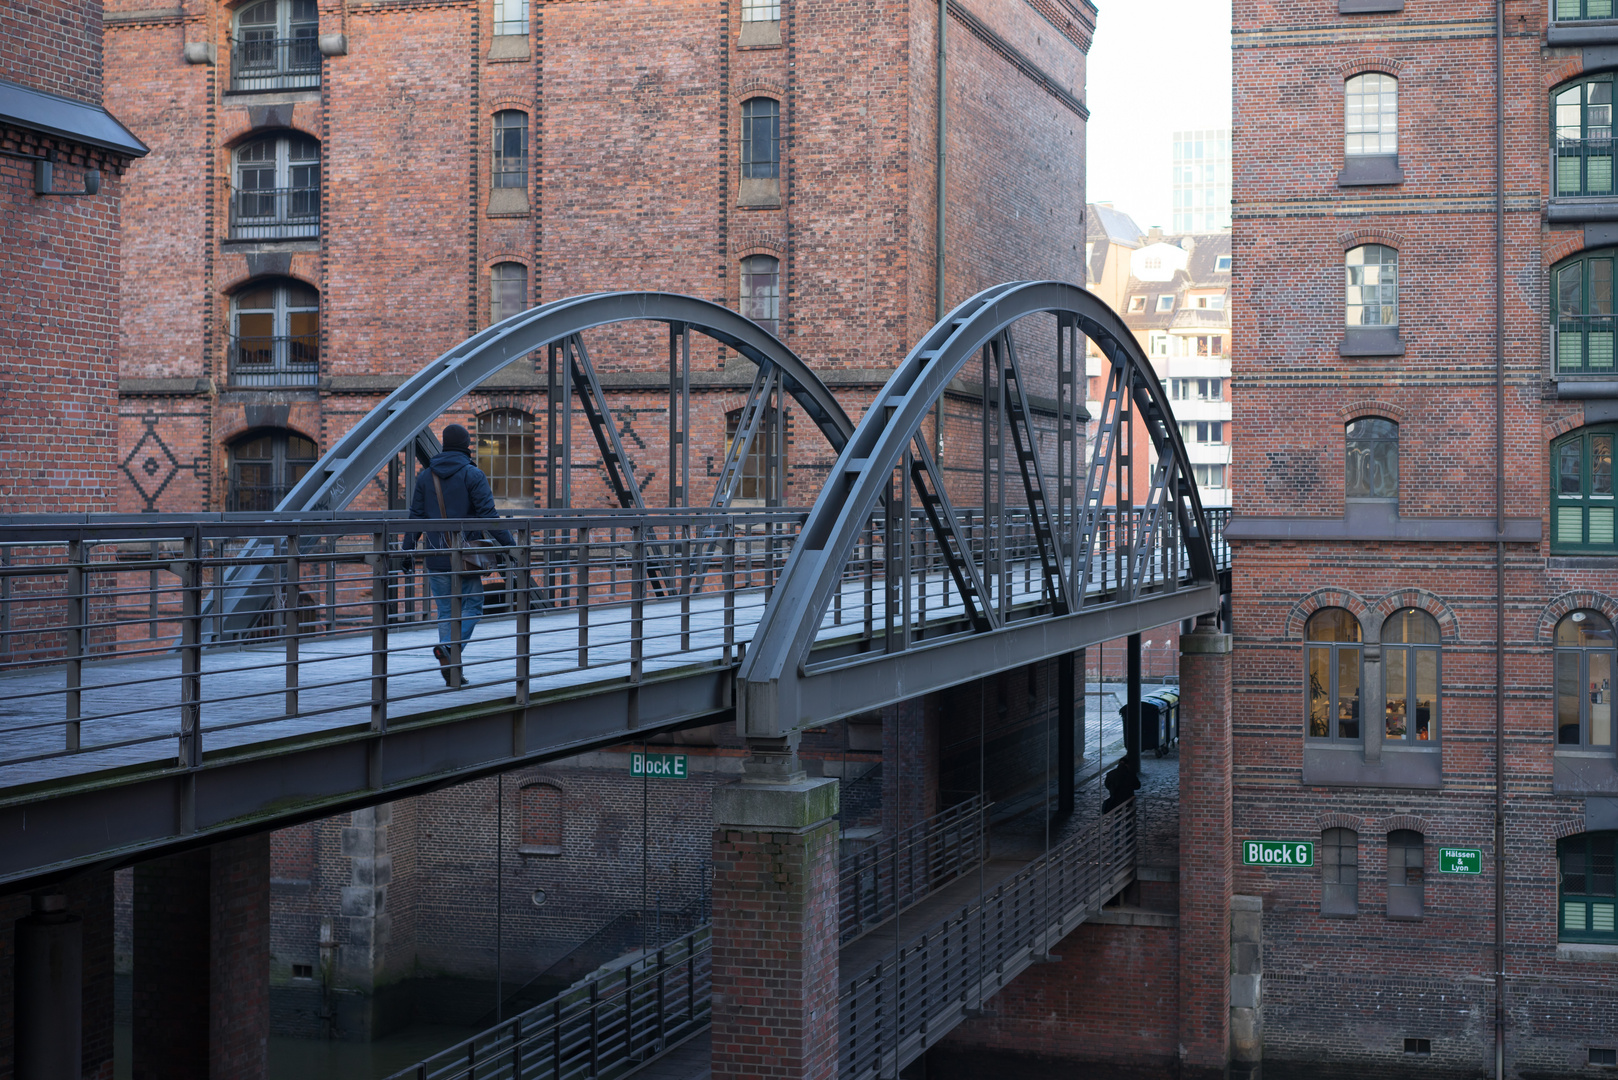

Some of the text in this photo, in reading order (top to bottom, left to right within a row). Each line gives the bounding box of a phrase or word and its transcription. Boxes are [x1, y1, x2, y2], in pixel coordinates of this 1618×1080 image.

[633, 754, 685, 775] Block E
[1249, 843, 1307, 864] Block G
[1445, 850, 1475, 858] Hälssen
[1451, 864, 1469, 872] Lyon
